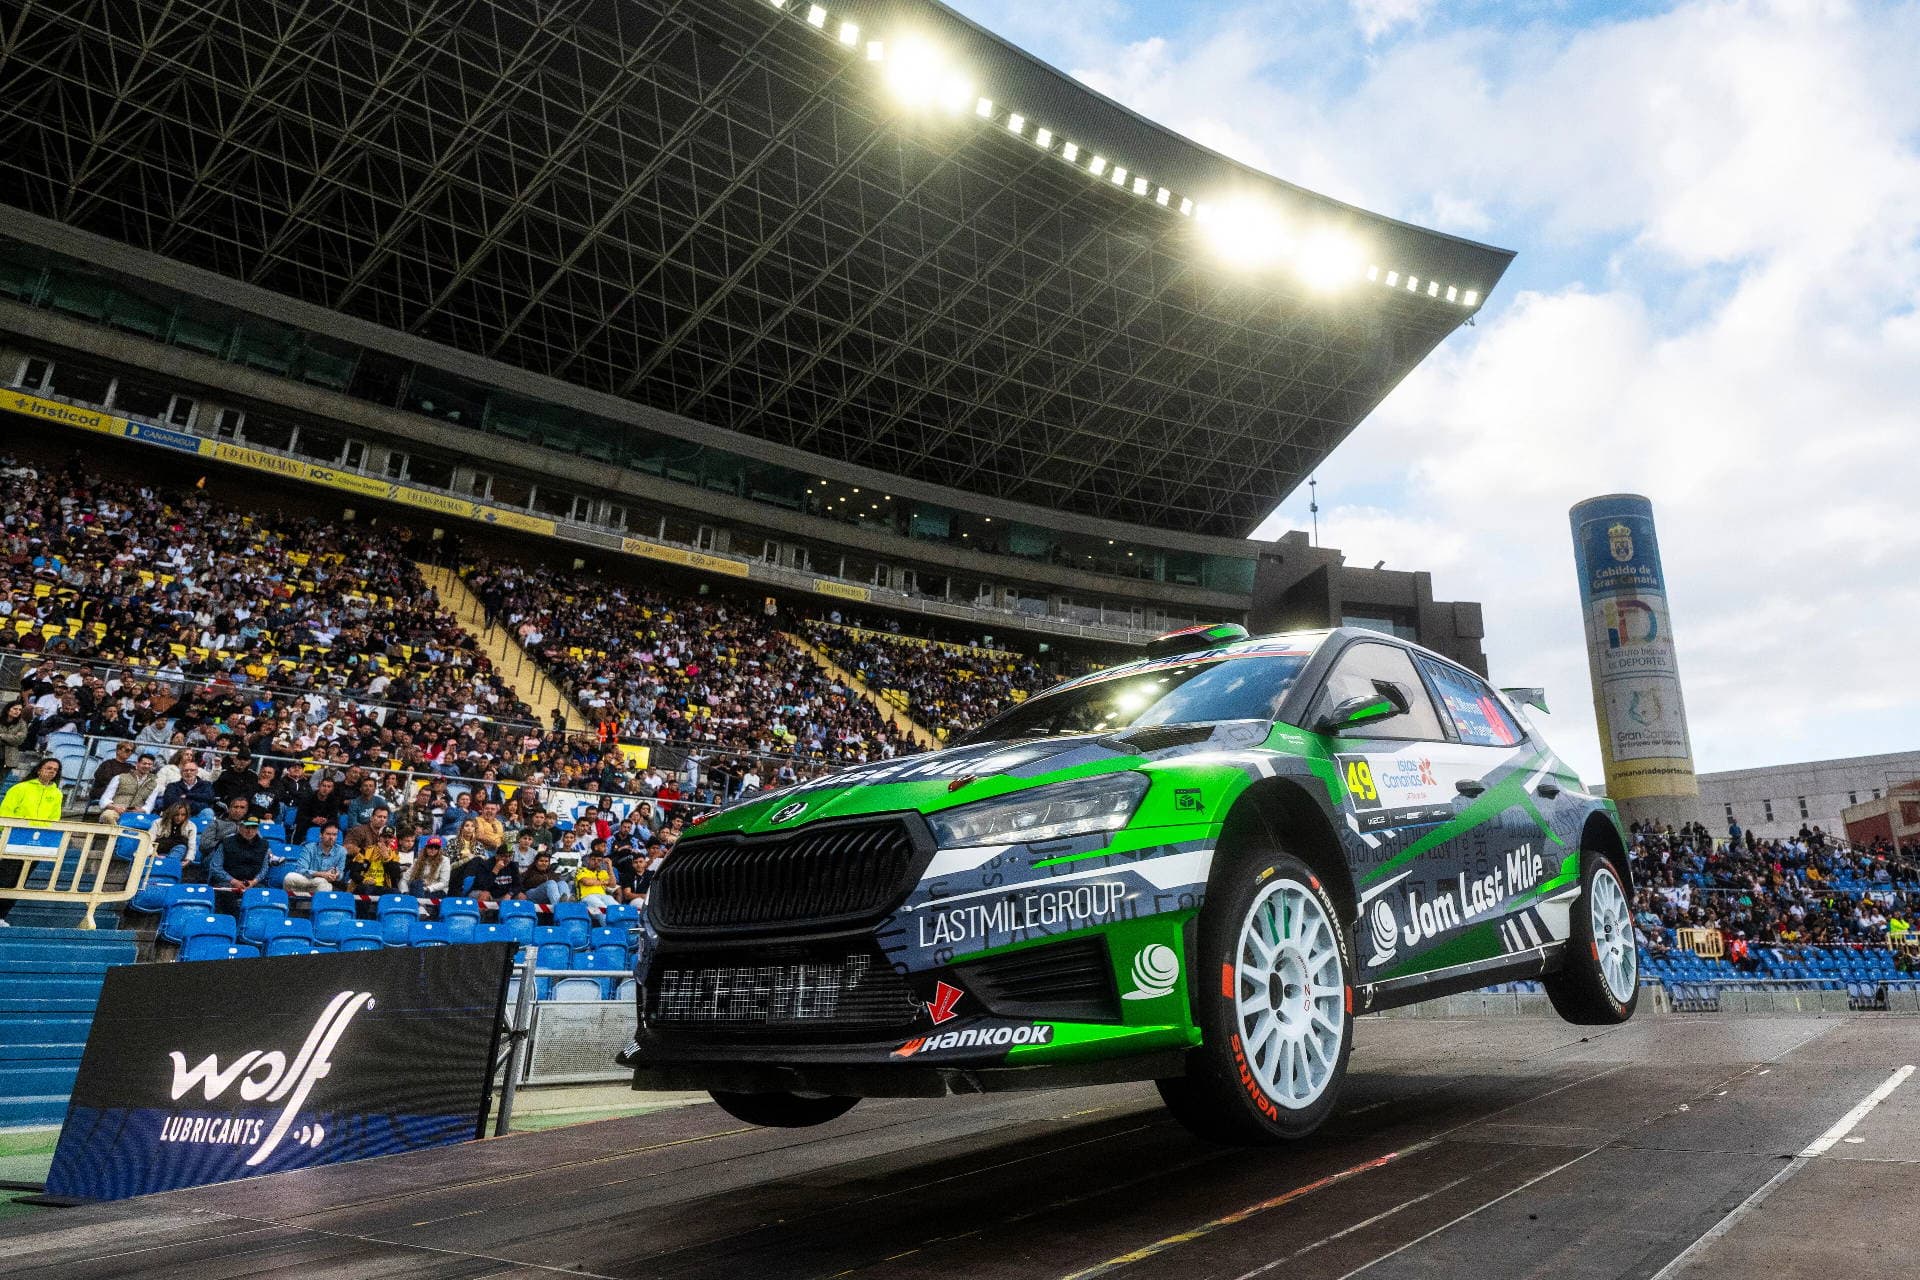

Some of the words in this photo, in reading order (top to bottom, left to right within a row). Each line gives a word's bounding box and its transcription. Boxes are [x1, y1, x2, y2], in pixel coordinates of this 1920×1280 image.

[31, 401, 100, 426] Insticod
[143, 429, 197, 448] CANARAGUA
[1596, 565, 1637, 578] Cabildo
[1640, 565, 1651, 574] de
[1593, 577, 1616, 589] Gran
[1618, 656, 1667, 668] DEPORTES
[1617, 731, 1641, 742] Gran
[1397, 759, 1418, 772] Islas
[1347, 761, 1377, 800] 49
[1382, 772, 1423, 789] Canarias
[1403, 891, 1460, 947] Jom
[1459, 865, 1504, 920] Last
[1506, 843, 1543, 896] Mile
[918, 881, 1126, 948] LASTMILEGROUP
[1230, 1032, 1279, 1122] ventus
[160, 1116, 264, 1145] LUBRICANTS
